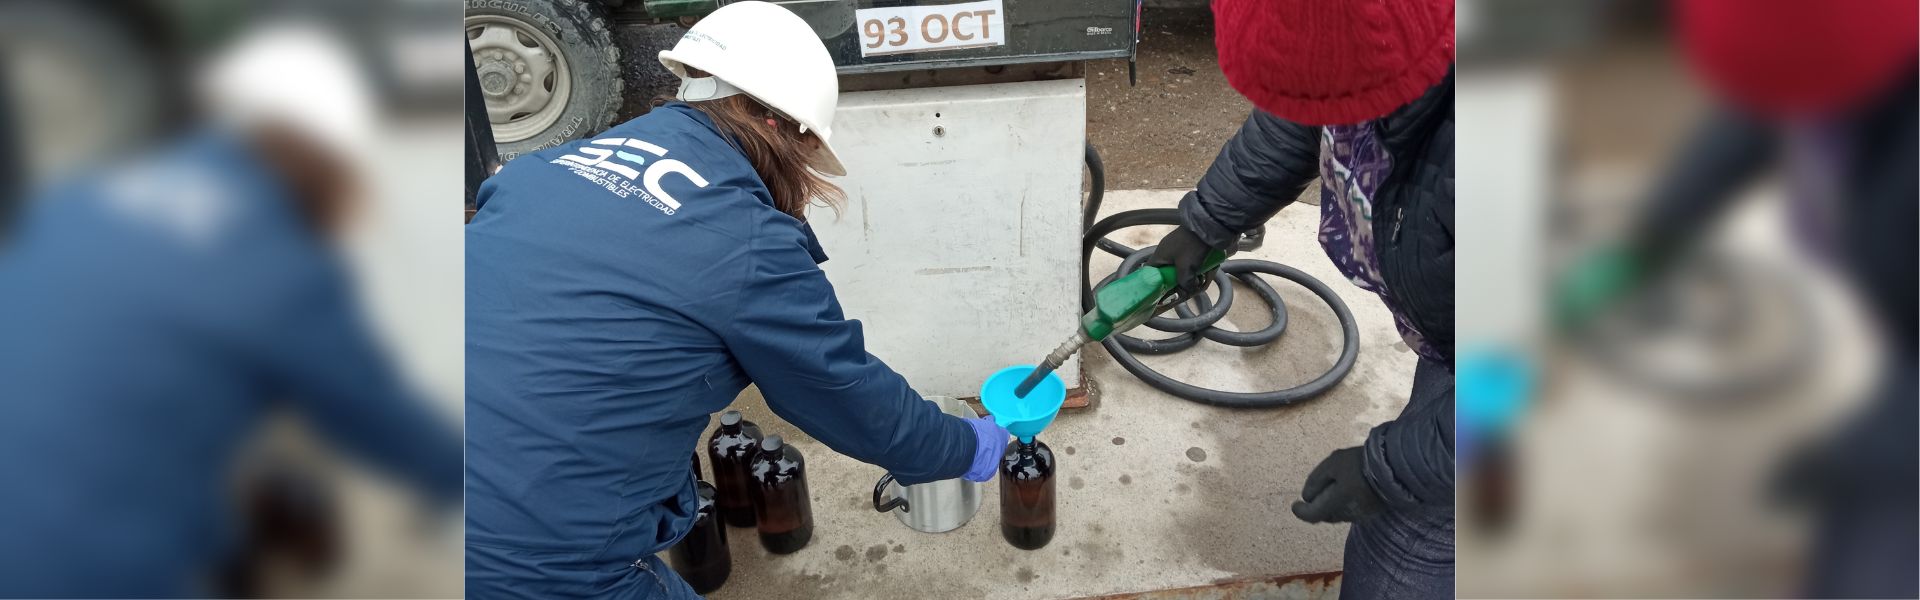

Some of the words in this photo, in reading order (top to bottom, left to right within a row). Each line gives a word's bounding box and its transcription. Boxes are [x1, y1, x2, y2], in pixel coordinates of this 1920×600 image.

[864, 16, 909, 48] 93
[921, 9, 996, 43] OCT
[558, 137, 710, 210] SEC
[574, 169, 630, 199] COMBUSTIBLES
[607, 170, 622, 184] DE
[621, 179, 675, 216] ELECTRICIDAD
